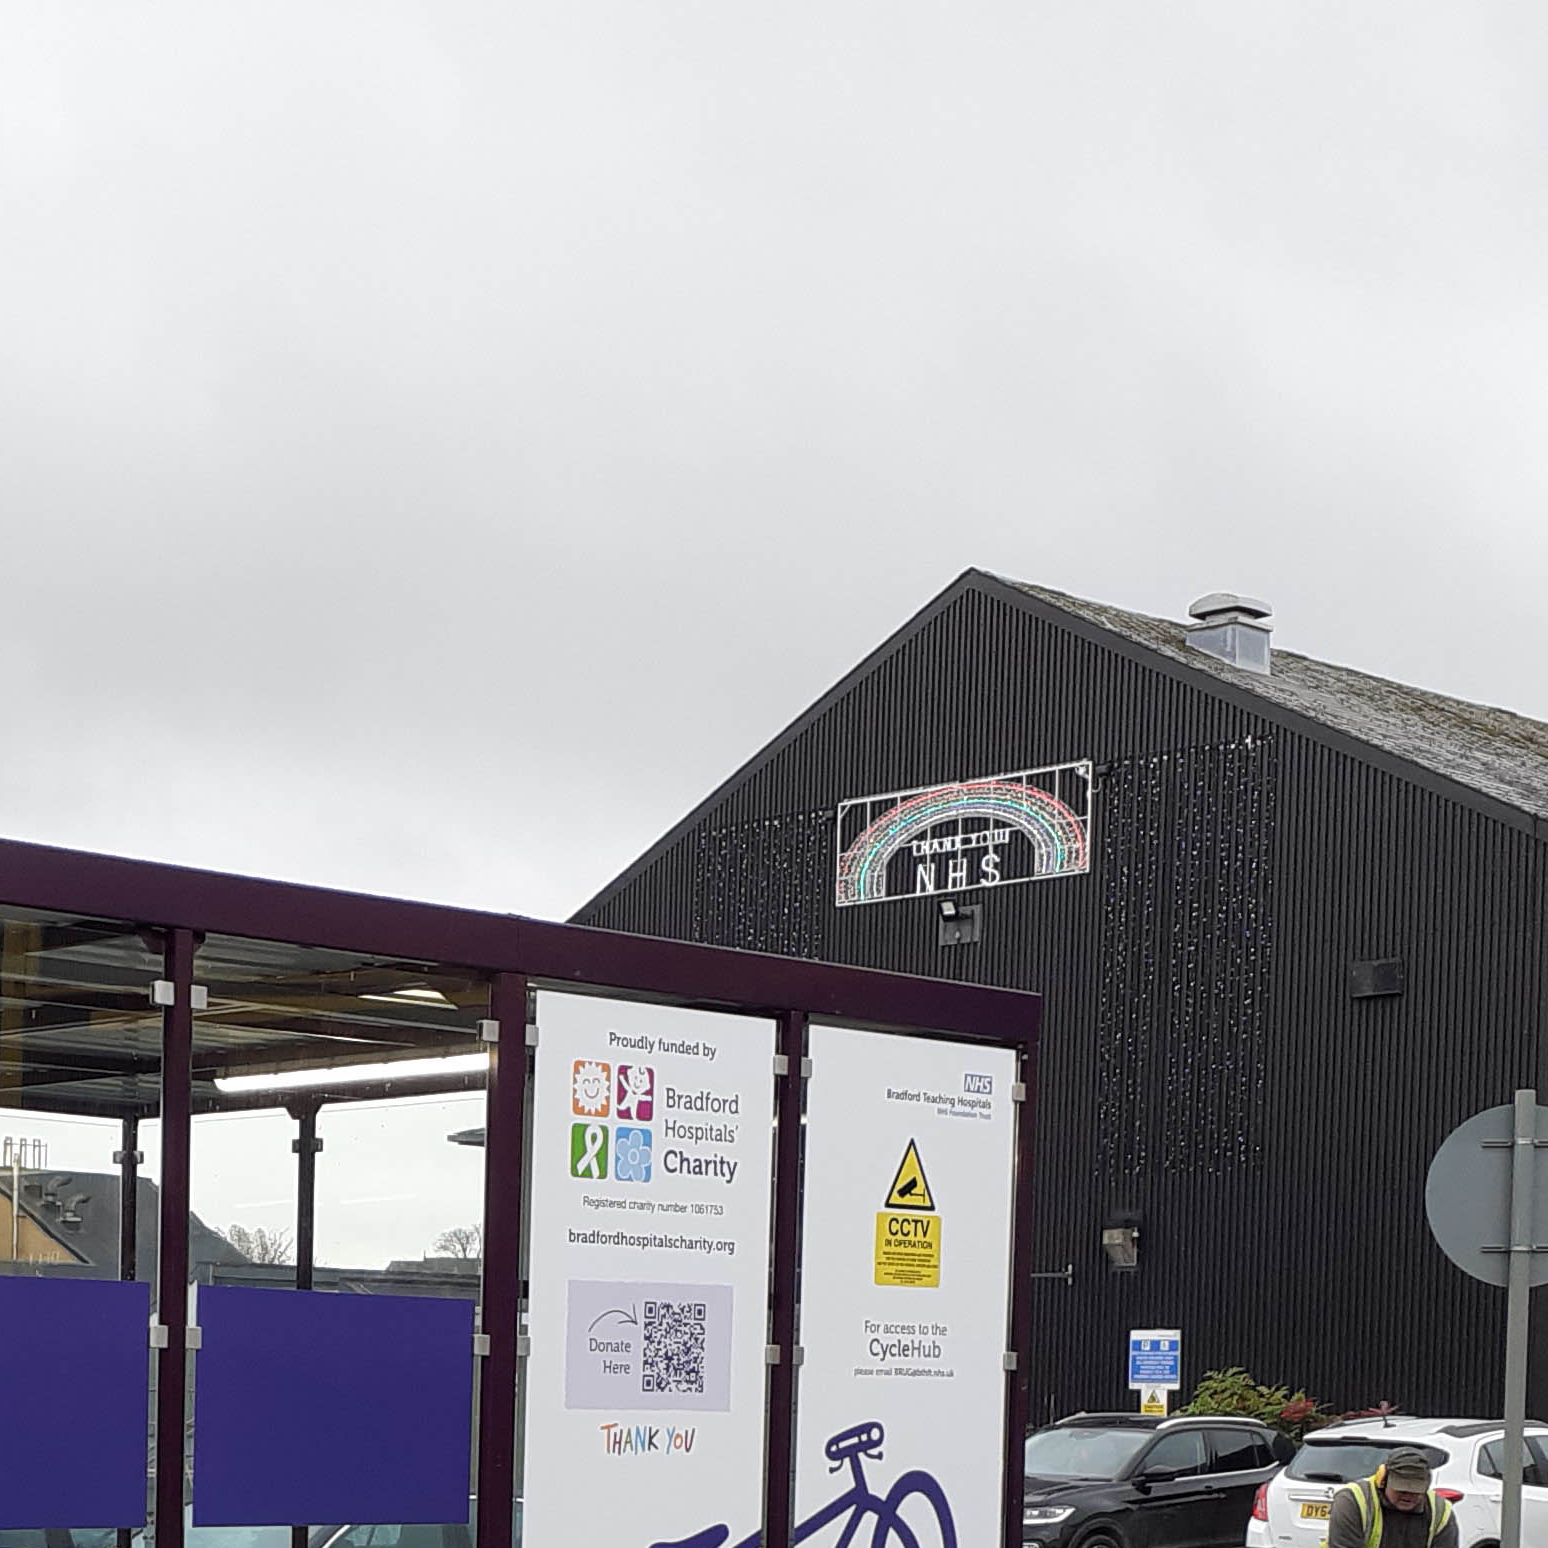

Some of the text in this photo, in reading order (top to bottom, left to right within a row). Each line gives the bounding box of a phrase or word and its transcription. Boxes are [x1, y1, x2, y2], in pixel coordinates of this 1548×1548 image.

[916, 853, 1000, 896] NHS
[609, 1032, 716, 1060] Proudly funded by
[965, 1075, 991, 1092] NHS
[666, 1088, 739, 1114] Bradford
[887, 1088, 991, 1110] Bradford Teaching Hospitals
[663, 1149, 738, 1183] Charity
[583, 1196, 626, 1210] Registered
[629, 1201, 655, 1213] charity
[658, 1204, 687, 1214] number
[888, 1217, 930, 1238] CCTV
[568, 1229, 735, 1255] bradfordhospitalscharity.org
[885, 1239, 933, 1249] IN OPERATION
[864, 1320, 947, 1336] For access to the
[589, 1338, 632, 1352] Donate
[869, 1338, 942, 1361] CycleHub
[603, 1360, 631, 1374] Here
[600, 1423, 695, 1455] THANK YOU
